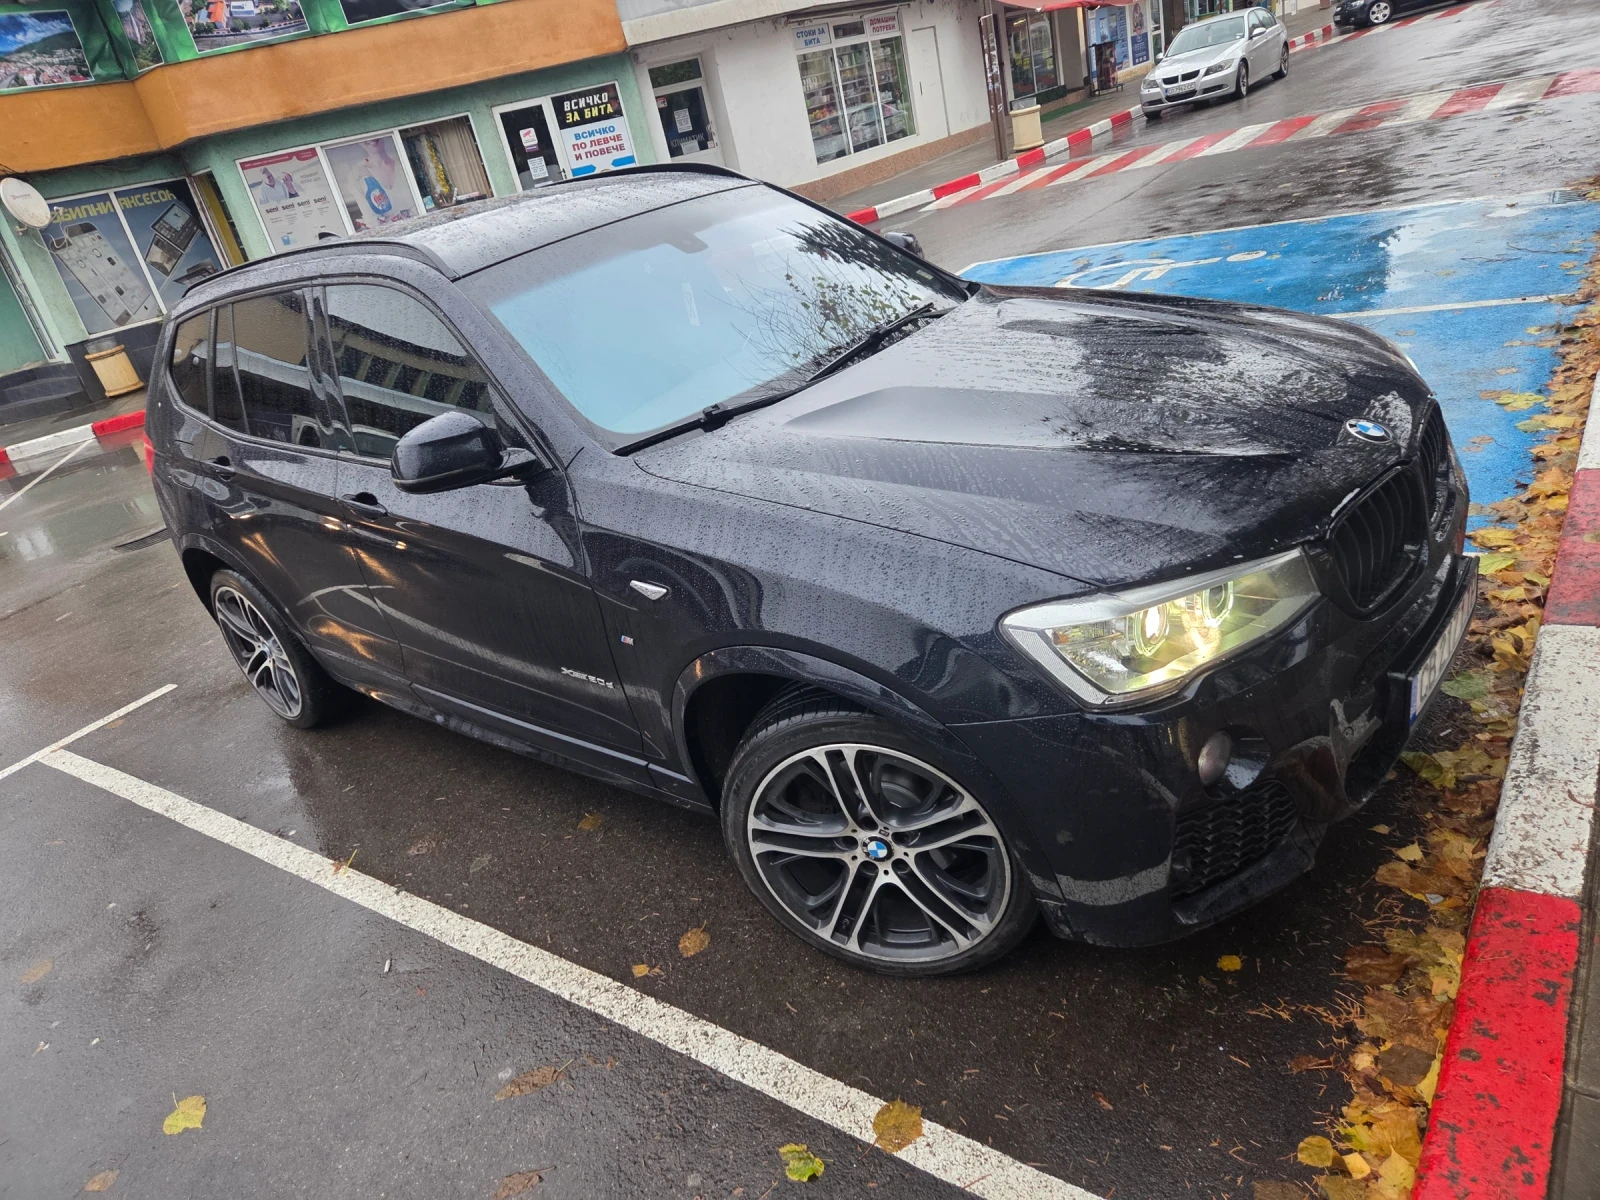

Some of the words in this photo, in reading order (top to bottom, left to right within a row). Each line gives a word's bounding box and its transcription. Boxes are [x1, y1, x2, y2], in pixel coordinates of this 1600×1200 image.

[796, 28, 816, 39] СТОКИ
[817, 27, 825, 35] ЗА
[804, 38, 820, 46] БИТА
[564, 92, 609, 111] ВСИЧКО
[566, 111, 581, 123] ЗА
[584, 103, 614, 119] БИТА
[574, 125, 616, 141] ВСИЧКО
[572, 142, 587, 151] ПО
[589, 133, 623, 148] ЛЕВЧЕ
[575, 152, 583, 161] И
[585, 143, 626, 159] ПОВЕЧЕ
[281, 202, 295, 211] seni
[313, 195, 327, 204] seni
